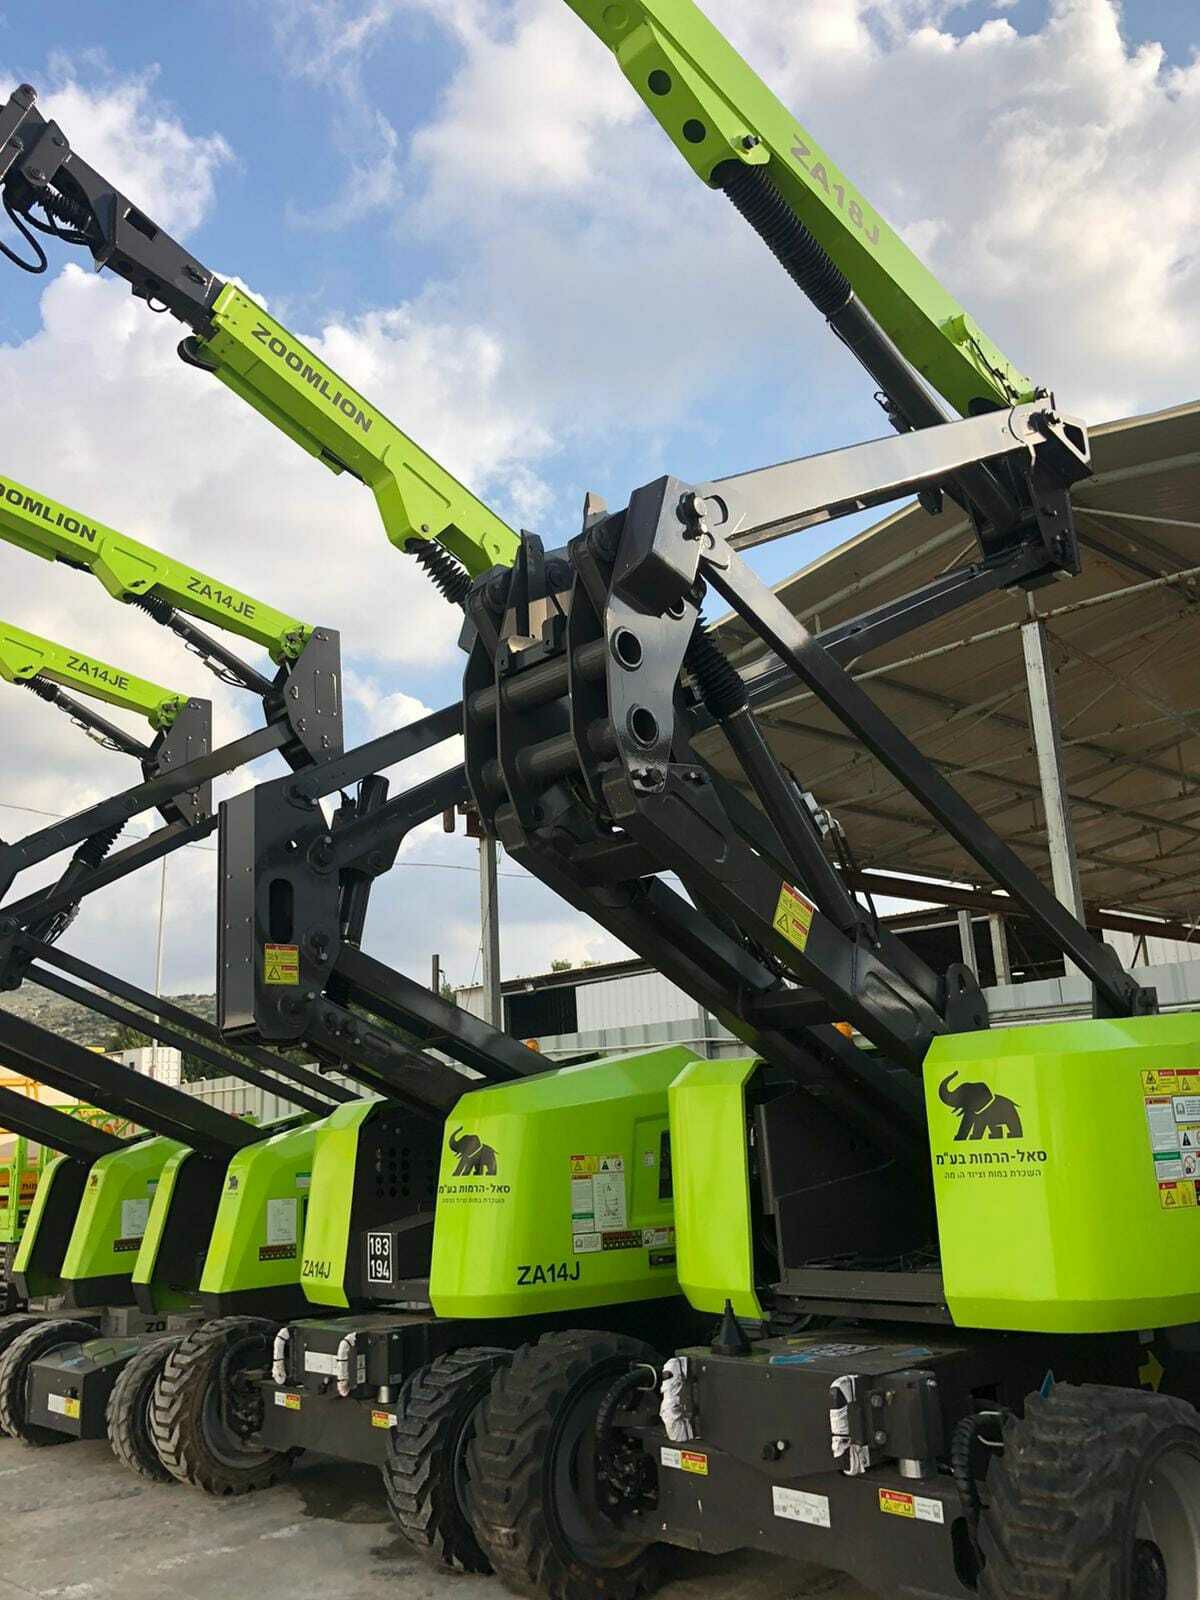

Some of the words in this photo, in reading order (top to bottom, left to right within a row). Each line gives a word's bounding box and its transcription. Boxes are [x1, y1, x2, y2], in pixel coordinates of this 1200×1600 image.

[790, 133, 880, 245] ZA18J
[251, 321, 372, 432] ZOOMLION
[0, 483, 97, 542] OMLION
[187, 576, 256, 619] ZA14JE
[66, 656, 129, 690] ZA14JE
[370, 1237, 389, 1256] 183
[302, 1260, 331, 1279] ZA14J
[370, 1259, 389, 1279] 194
[517, 1261, 580, 1285] ZA14J
